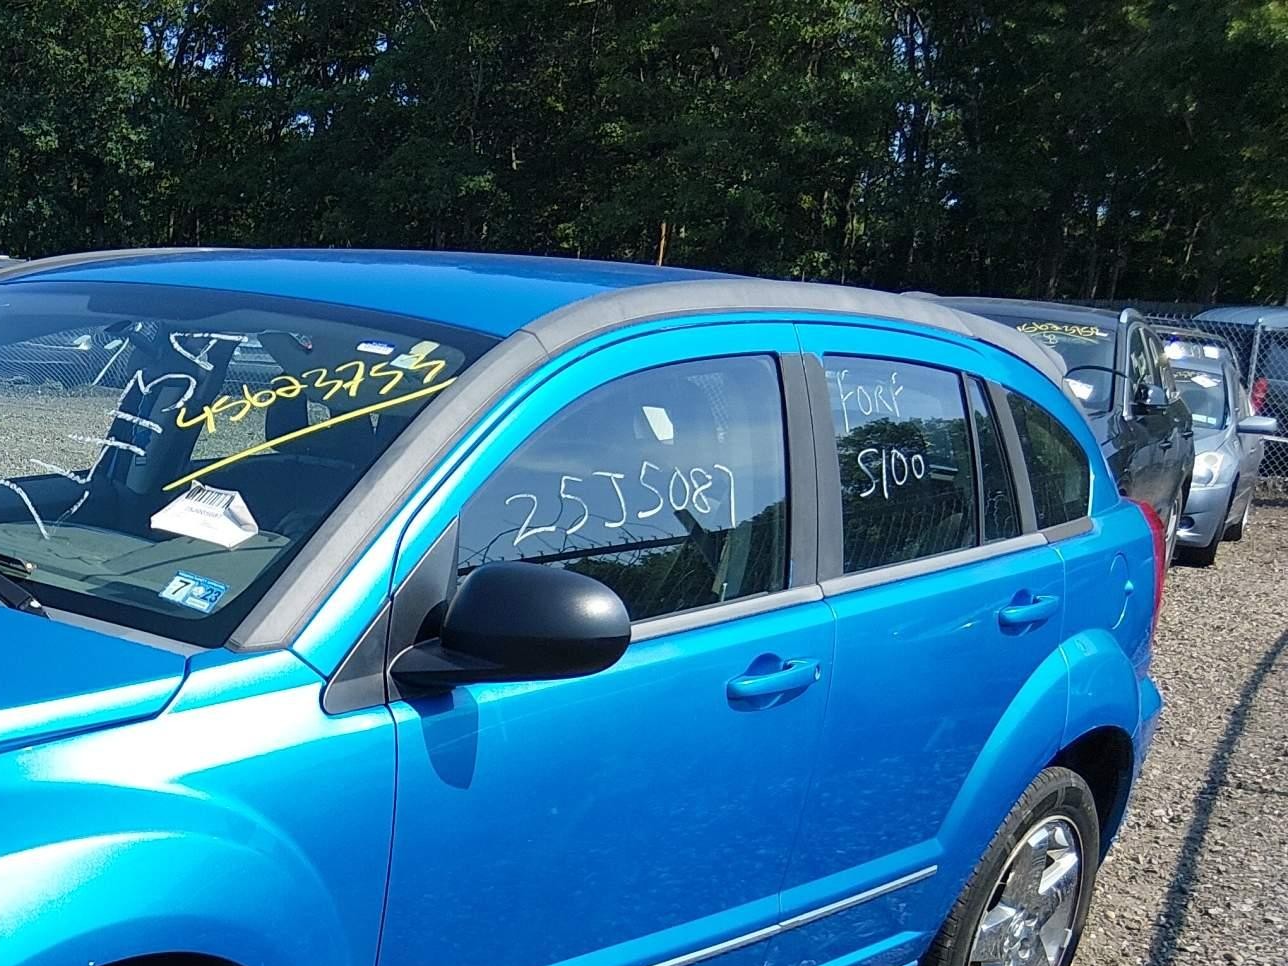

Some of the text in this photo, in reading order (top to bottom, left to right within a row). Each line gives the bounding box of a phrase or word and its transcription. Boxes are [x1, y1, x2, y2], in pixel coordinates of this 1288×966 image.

[176, 359, 446, 433] 45623753
[172, 579, 222, 603] 7 23
